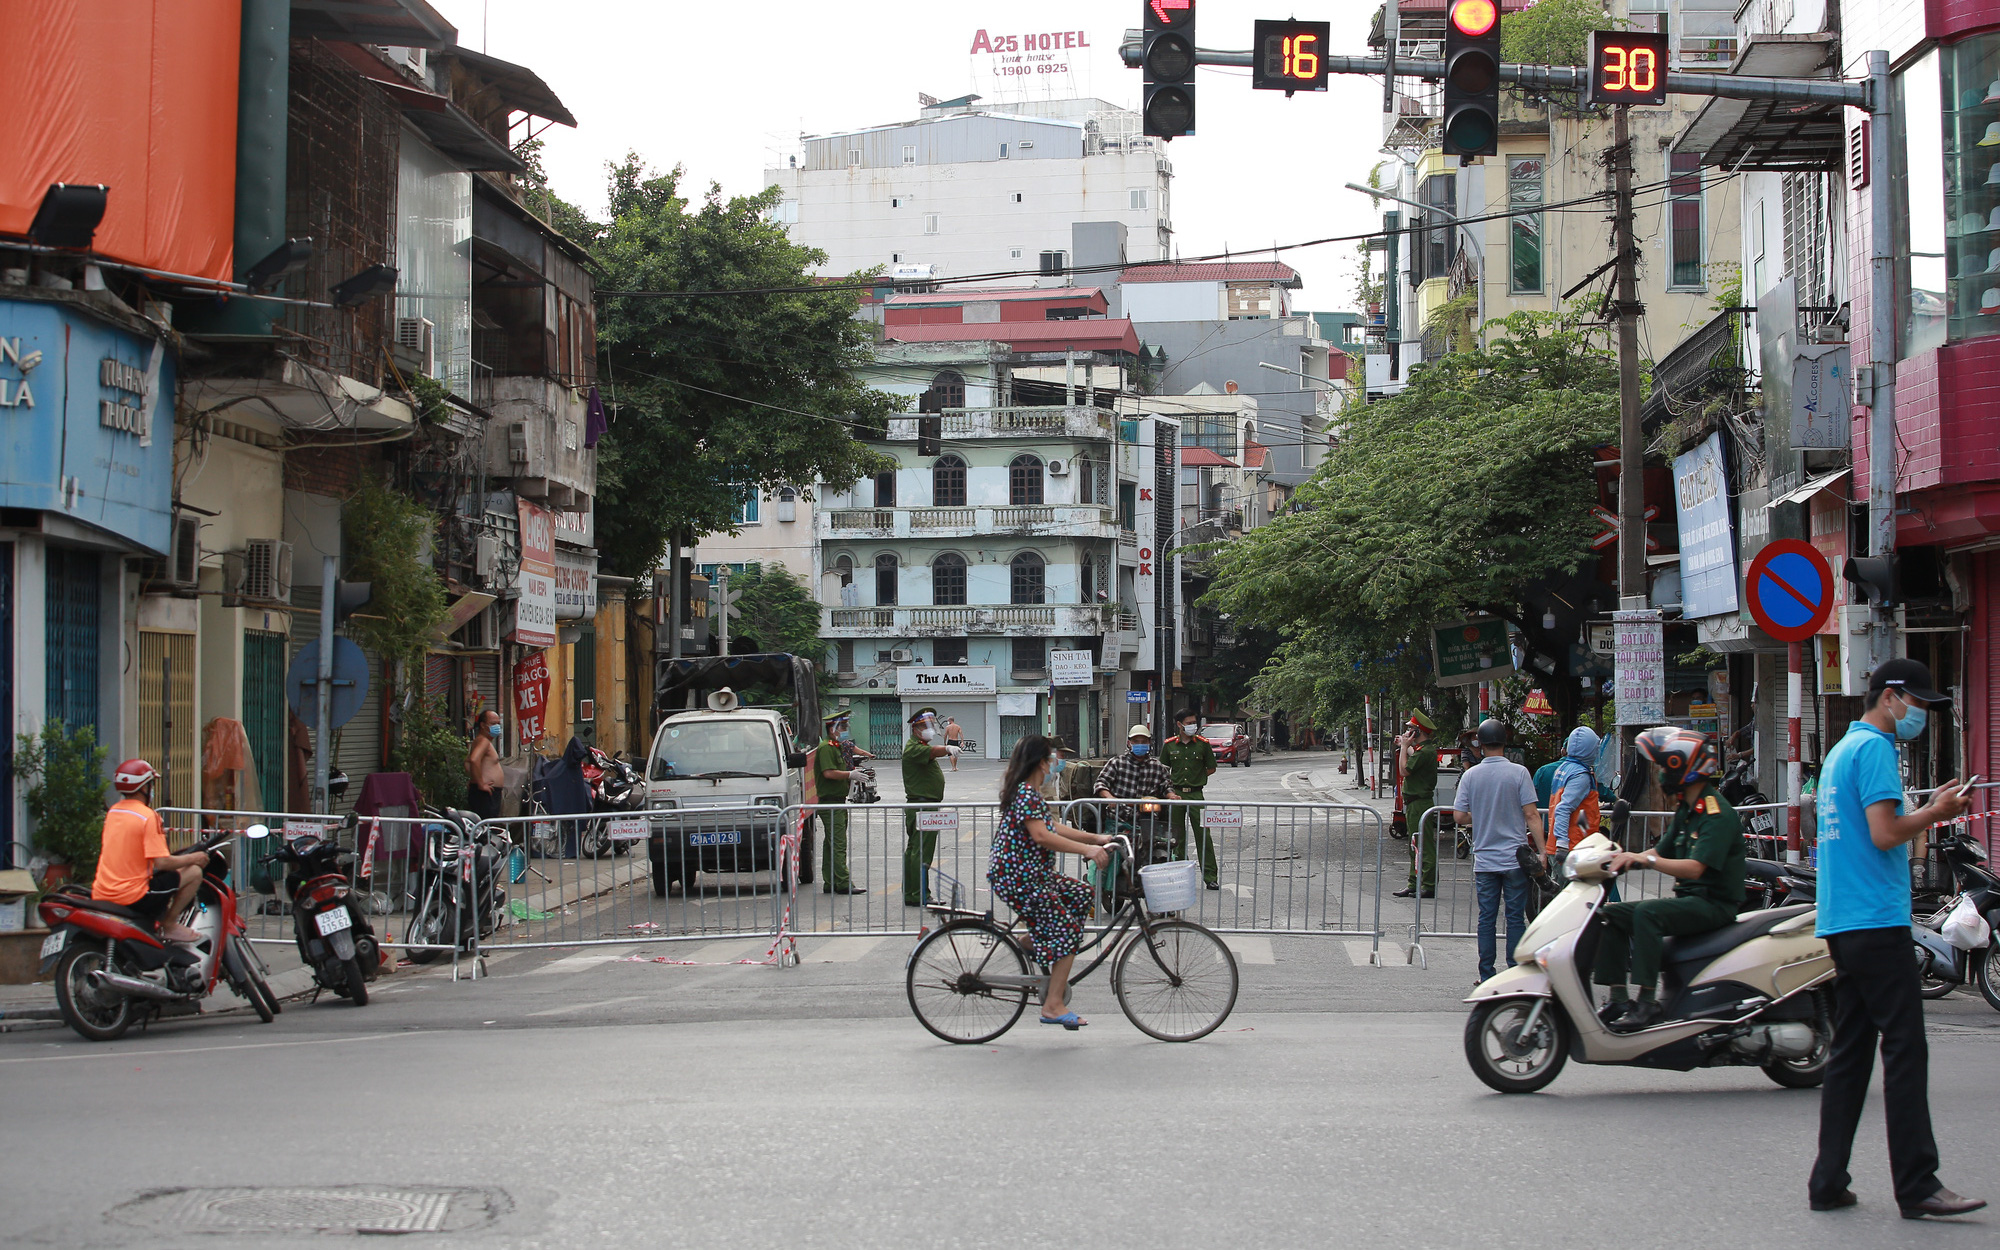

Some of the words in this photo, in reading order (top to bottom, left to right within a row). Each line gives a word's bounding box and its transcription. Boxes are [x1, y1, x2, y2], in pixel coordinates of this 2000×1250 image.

[970, 28, 1018, 54] A25
[1024, 31, 1090, 51] HOTEL
[1001, 55, 1023, 63] Your
[1027, 53, 1055, 62] house
[1283, 34, 1318, 79] 16
[1603, 46, 1655, 91] 30
[1002, 65, 1031, 76] 1900
[1037, 63, 1068, 74] 6925
[0, 379, 35, 407] LA
[1803, 360, 1818, 413] ALCOREST
[1139, 488, 1153, 501] K
[526, 512, 550, 553] ENEOS
[1053, 653, 1074, 661] SINH
[1076, 651, 1090, 661] TÀI
[1443, 655, 1458, 664] THAY
[1826, 650, 1838, 668] X
[916, 674, 939, 684] Thư
[942, 673, 967, 684] Anh
[518, 686, 537, 710] XE
[520, 715, 541, 739] XE
